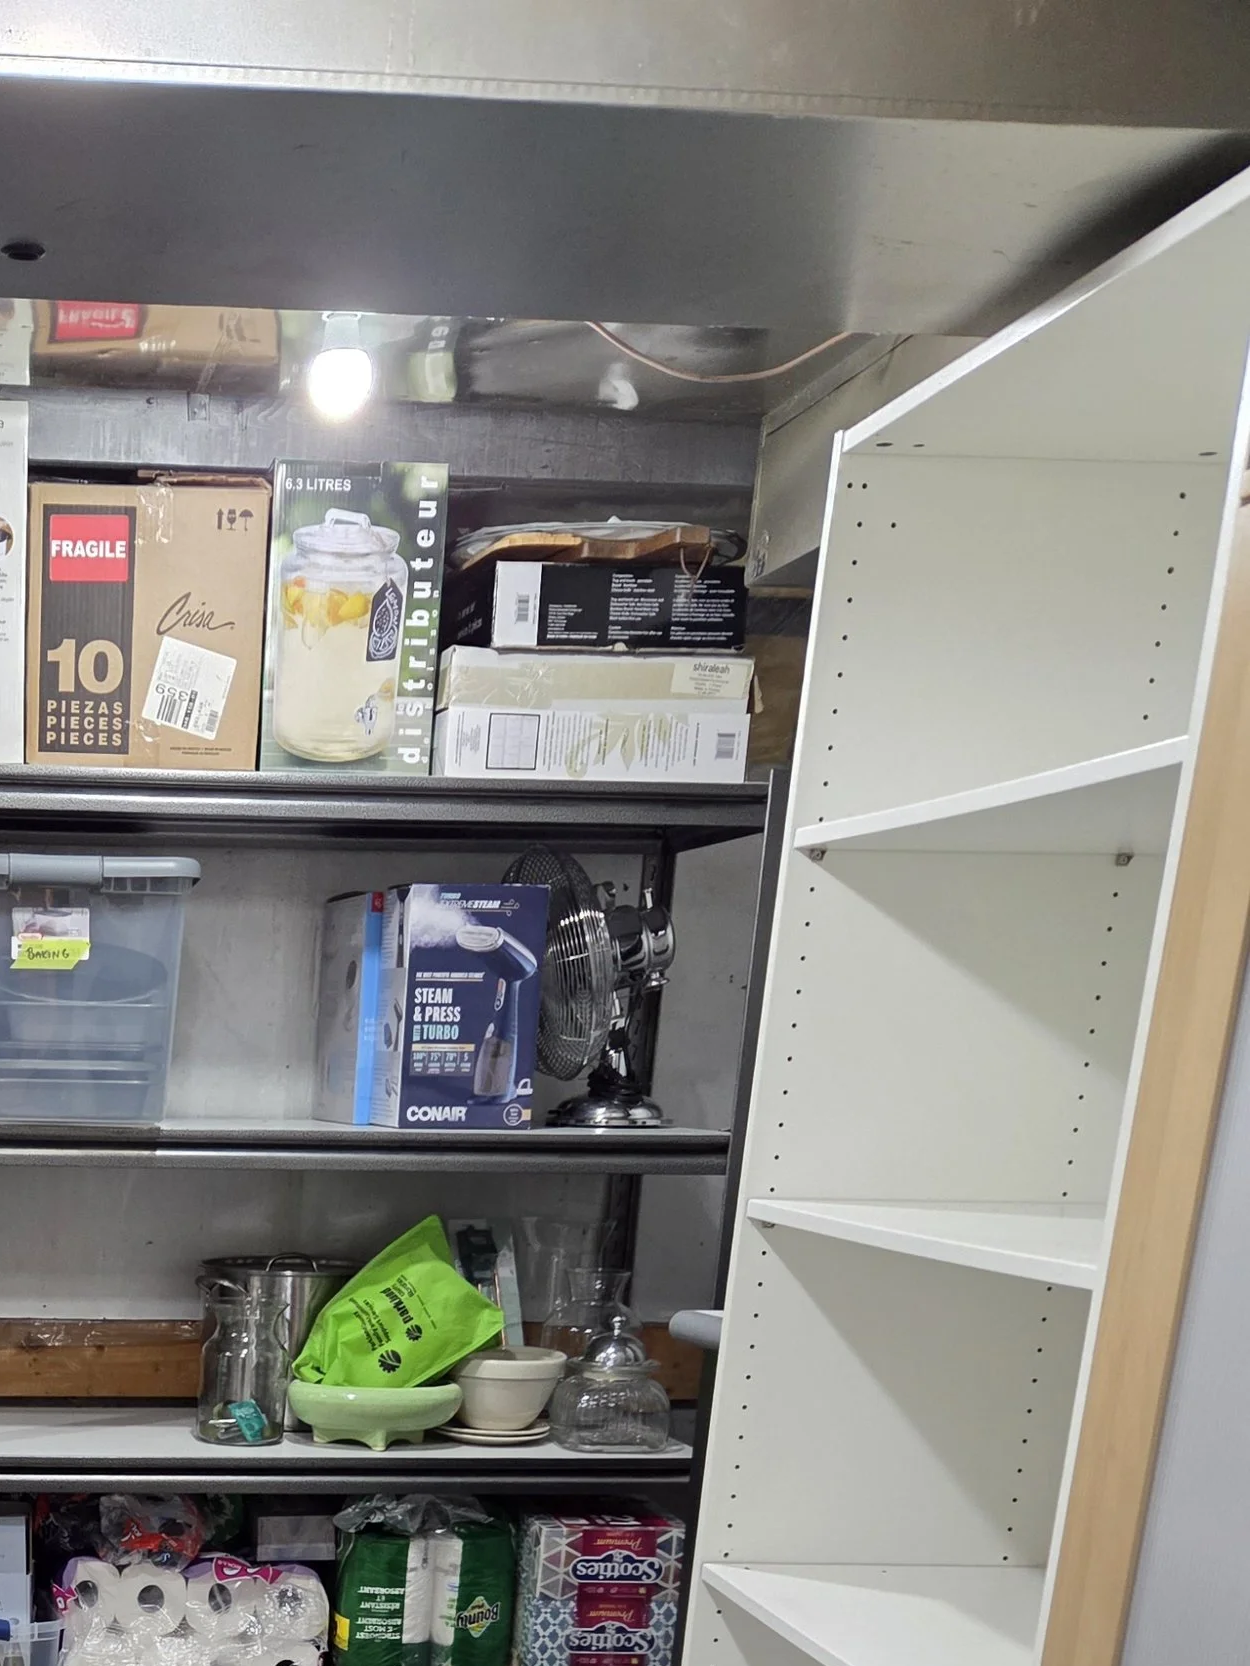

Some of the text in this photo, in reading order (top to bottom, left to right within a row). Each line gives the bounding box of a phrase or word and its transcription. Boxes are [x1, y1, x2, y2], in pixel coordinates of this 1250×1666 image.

[285, 478, 352, 492] 6.3 LITRES
[50, 539, 127, 559] FRAGILE
[157, 591, 236, 636] Crisa
[397, 475, 440, 765] distributeur
[46, 638, 125, 695] 10
[693, 661, 730, 674] shiraleah
[46, 700, 124, 714] PIEZAS
[46, 716, 123, 730] PIECES
[46, 731, 122, 746] PIECES
[26, 946, 70, 960] BAKING
[414, 988, 453, 1004] STEAM
[413, 1006, 461, 1023] & PRESS
[422, 1025, 459, 1041] TURBO
[406, 1106, 468, 1122] CONAIR
[593, 1536, 645, 1550] Premium
[575, 1557, 661, 1582] Scotties
[455, 1601, 500, 1628] Bounty
[568, 1631, 653, 1654] Scotties
